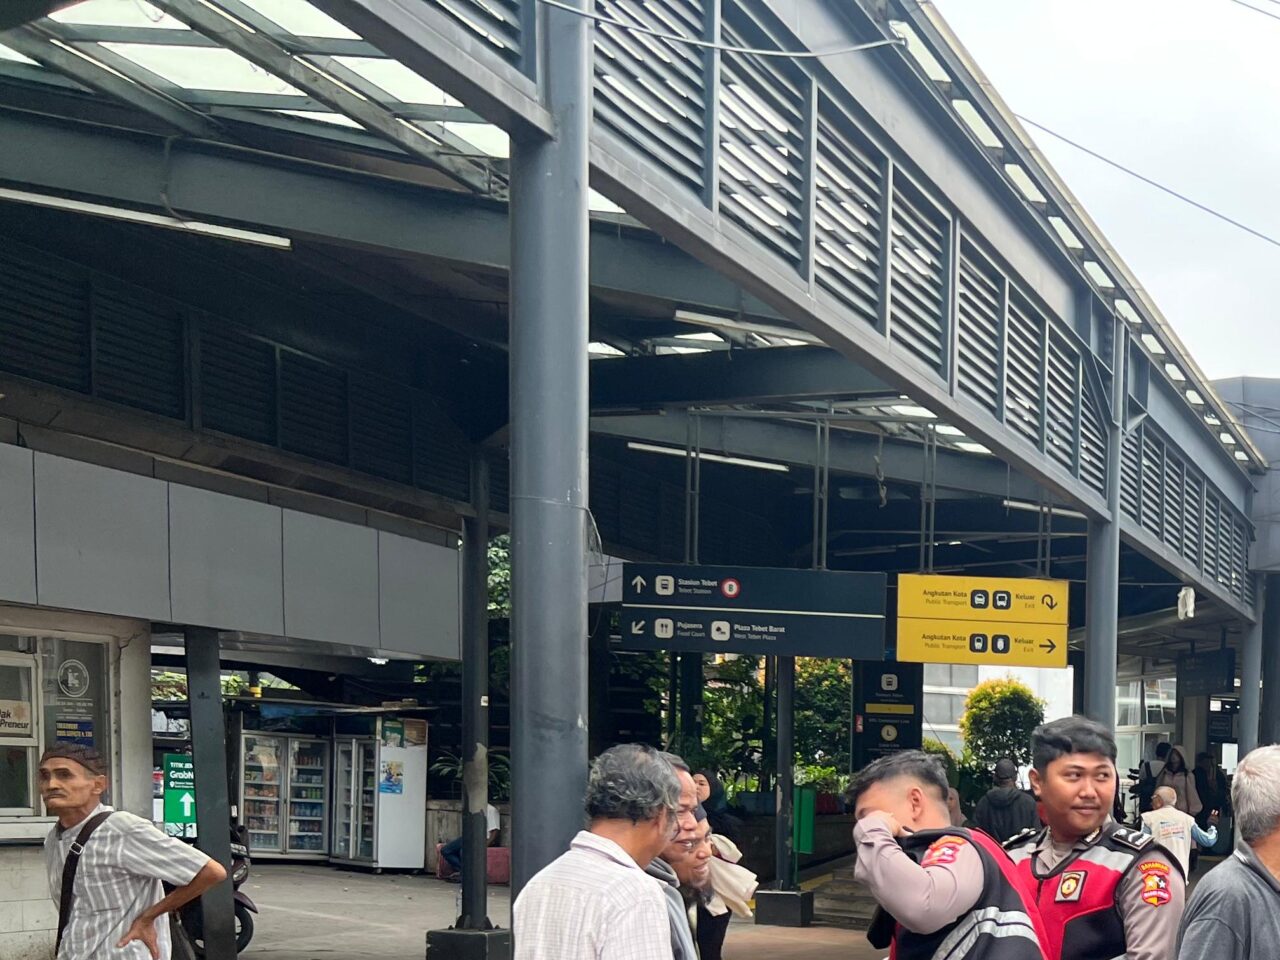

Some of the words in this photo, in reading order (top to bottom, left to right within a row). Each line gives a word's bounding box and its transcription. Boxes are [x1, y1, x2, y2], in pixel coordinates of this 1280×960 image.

[701, 579, 718, 587] Tebet
[923, 589, 953, 598] Angkutan
[1015, 593, 1035, 601] Keluar
[942, 599, 968, 607] Transport
[677, 621, 703, 630] Pujasera
[734, 624, 751, 632] Plaza
[769, 625, 785, 633] Barat
[922, 633, 952, 642] Angkutan
[1014, 637, 1034, 645] Keluar
[942, 643, 966, 651] Transport
[0, 709, 11, 719] ak
